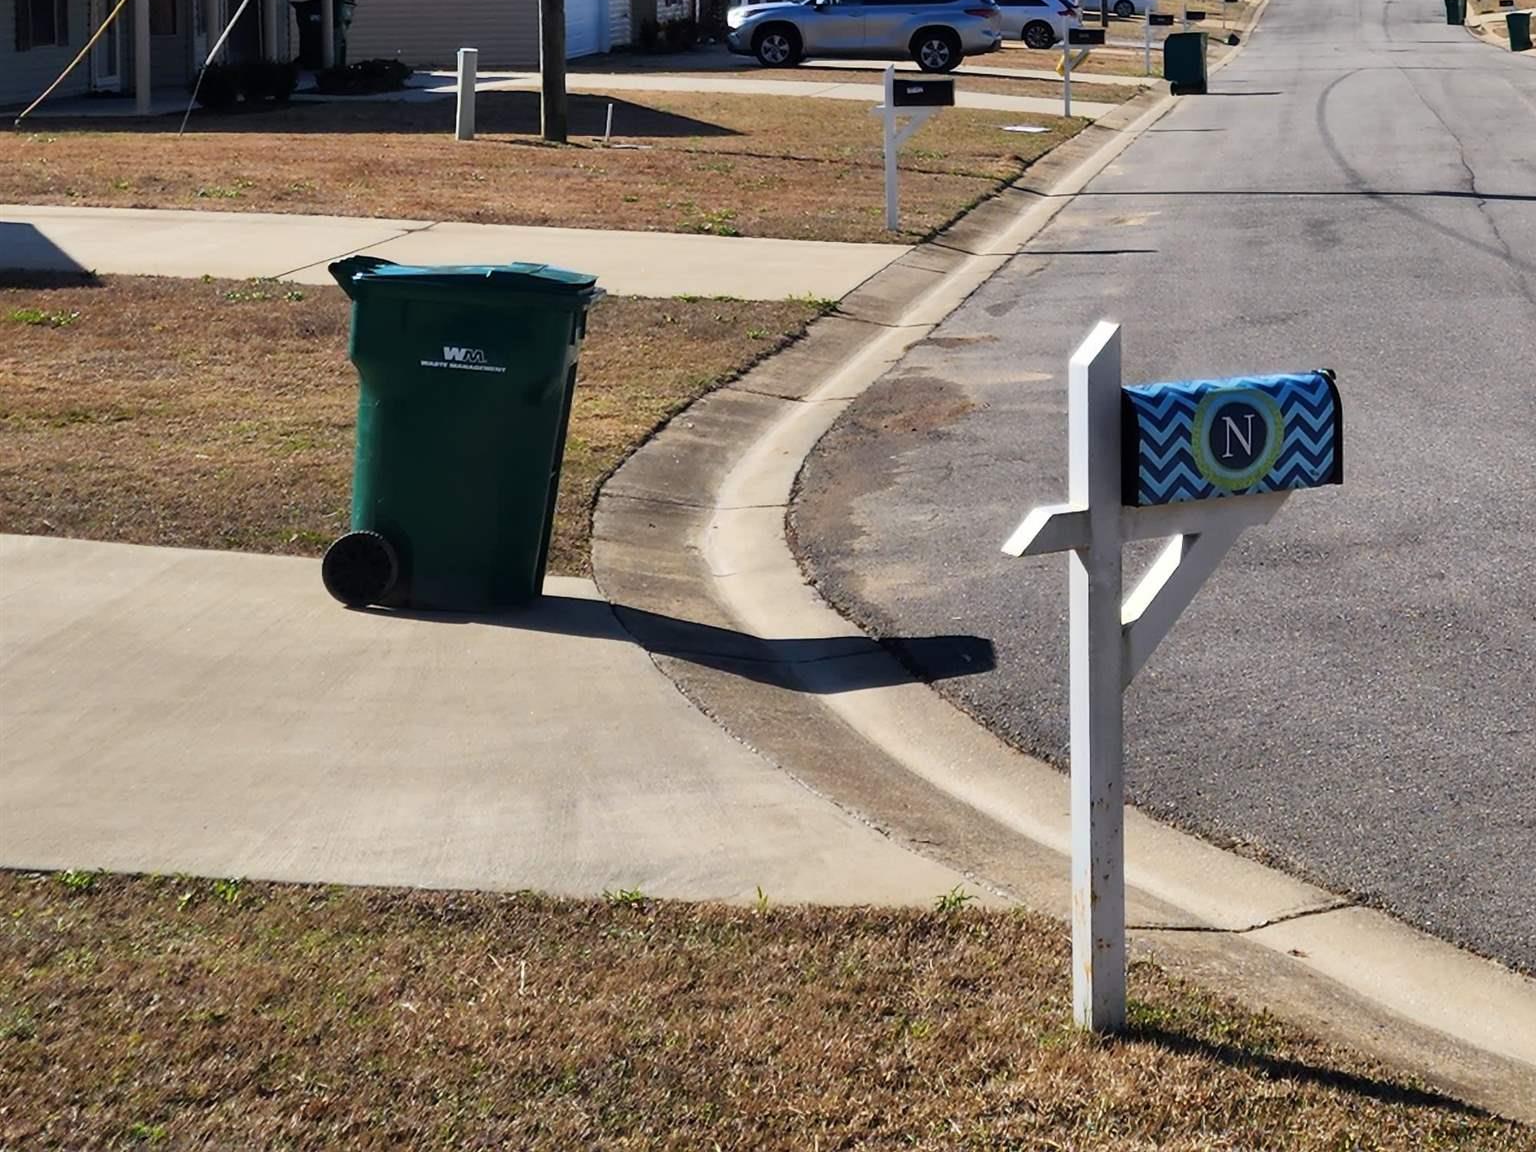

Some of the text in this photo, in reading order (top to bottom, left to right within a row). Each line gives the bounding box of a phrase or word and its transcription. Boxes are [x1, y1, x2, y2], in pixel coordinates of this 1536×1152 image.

[443, 346, 487, 364] WM
[420, 359, 507, 373] WASTE MANAGEMENT
[1221, 414, 1256, 459] N
